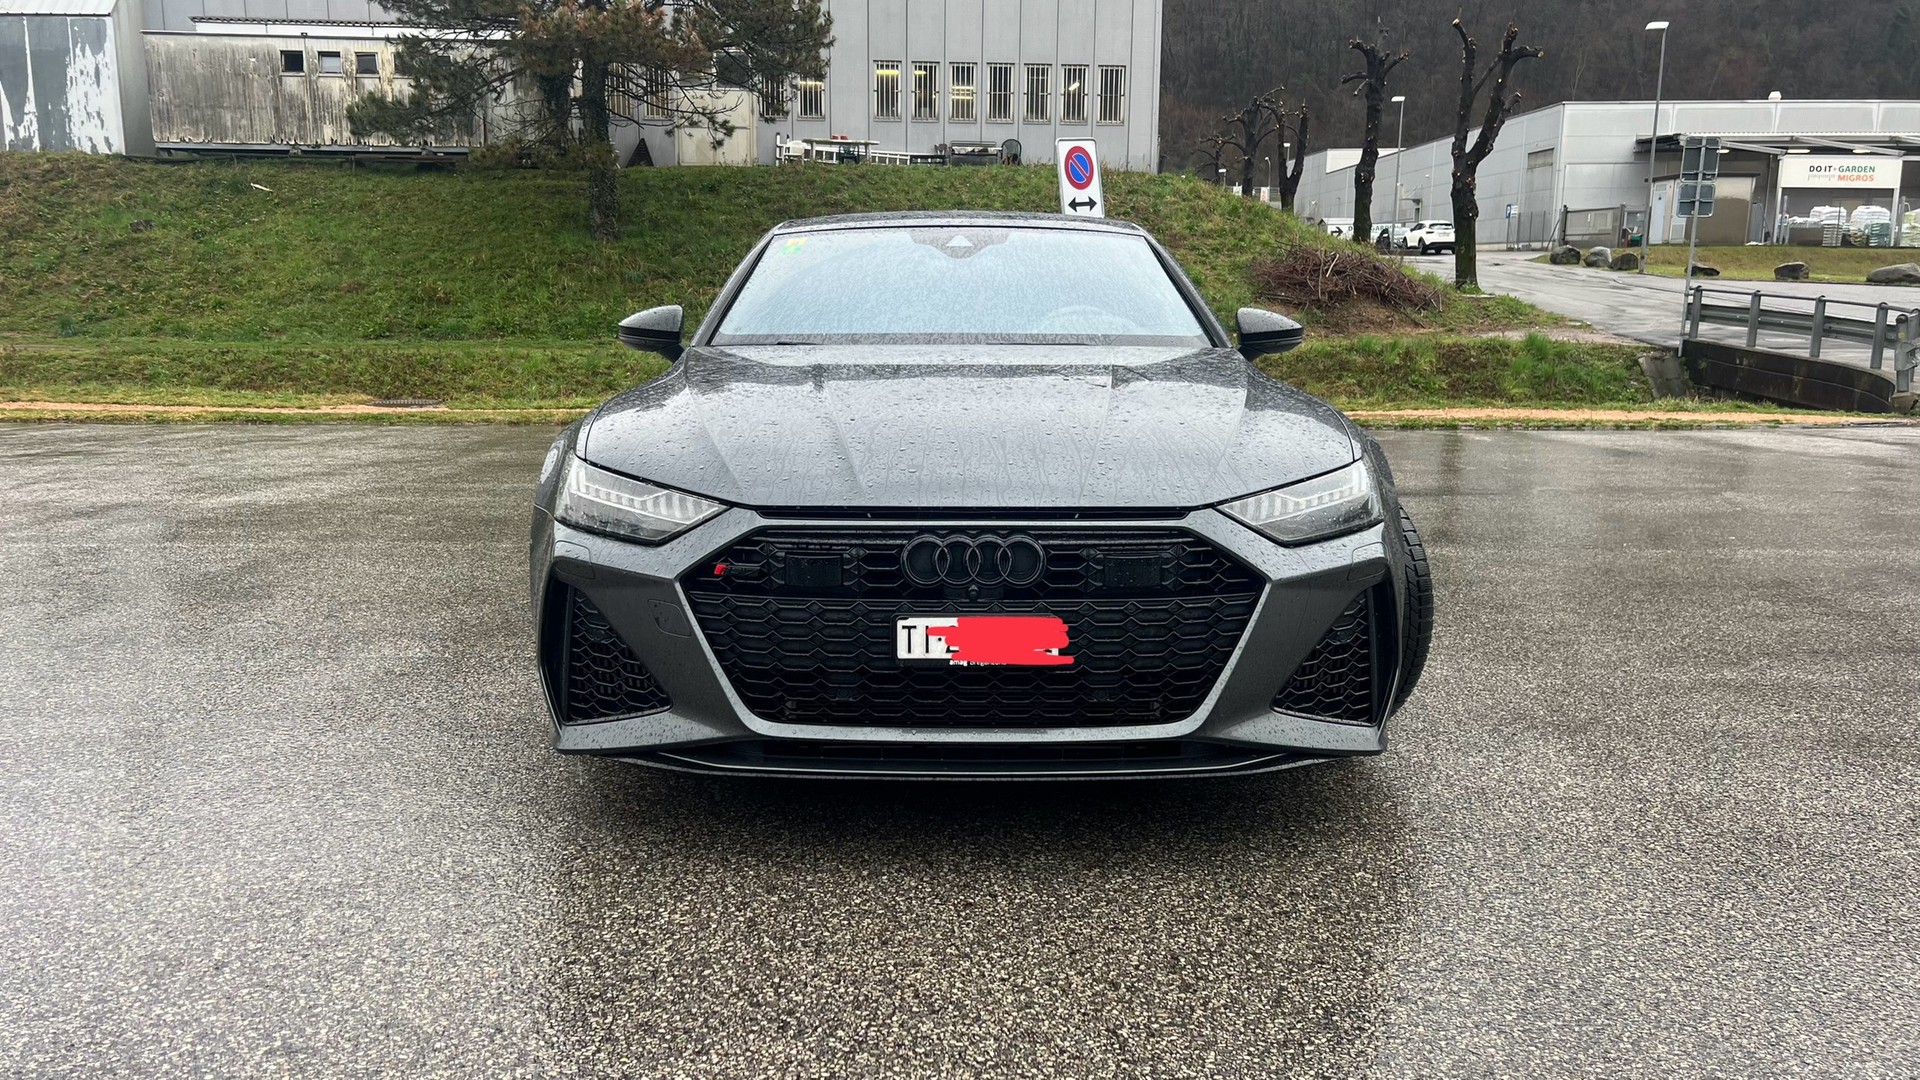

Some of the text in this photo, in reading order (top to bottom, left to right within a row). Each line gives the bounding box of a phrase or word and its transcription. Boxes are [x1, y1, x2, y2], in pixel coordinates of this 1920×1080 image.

[1809, 165, 1822, 173] DO
[1824, 165, 1833, 173] IT
[1838, 165, 1876, 173] GARDEN
[1837, 174, 1875, 182] MIGROS
